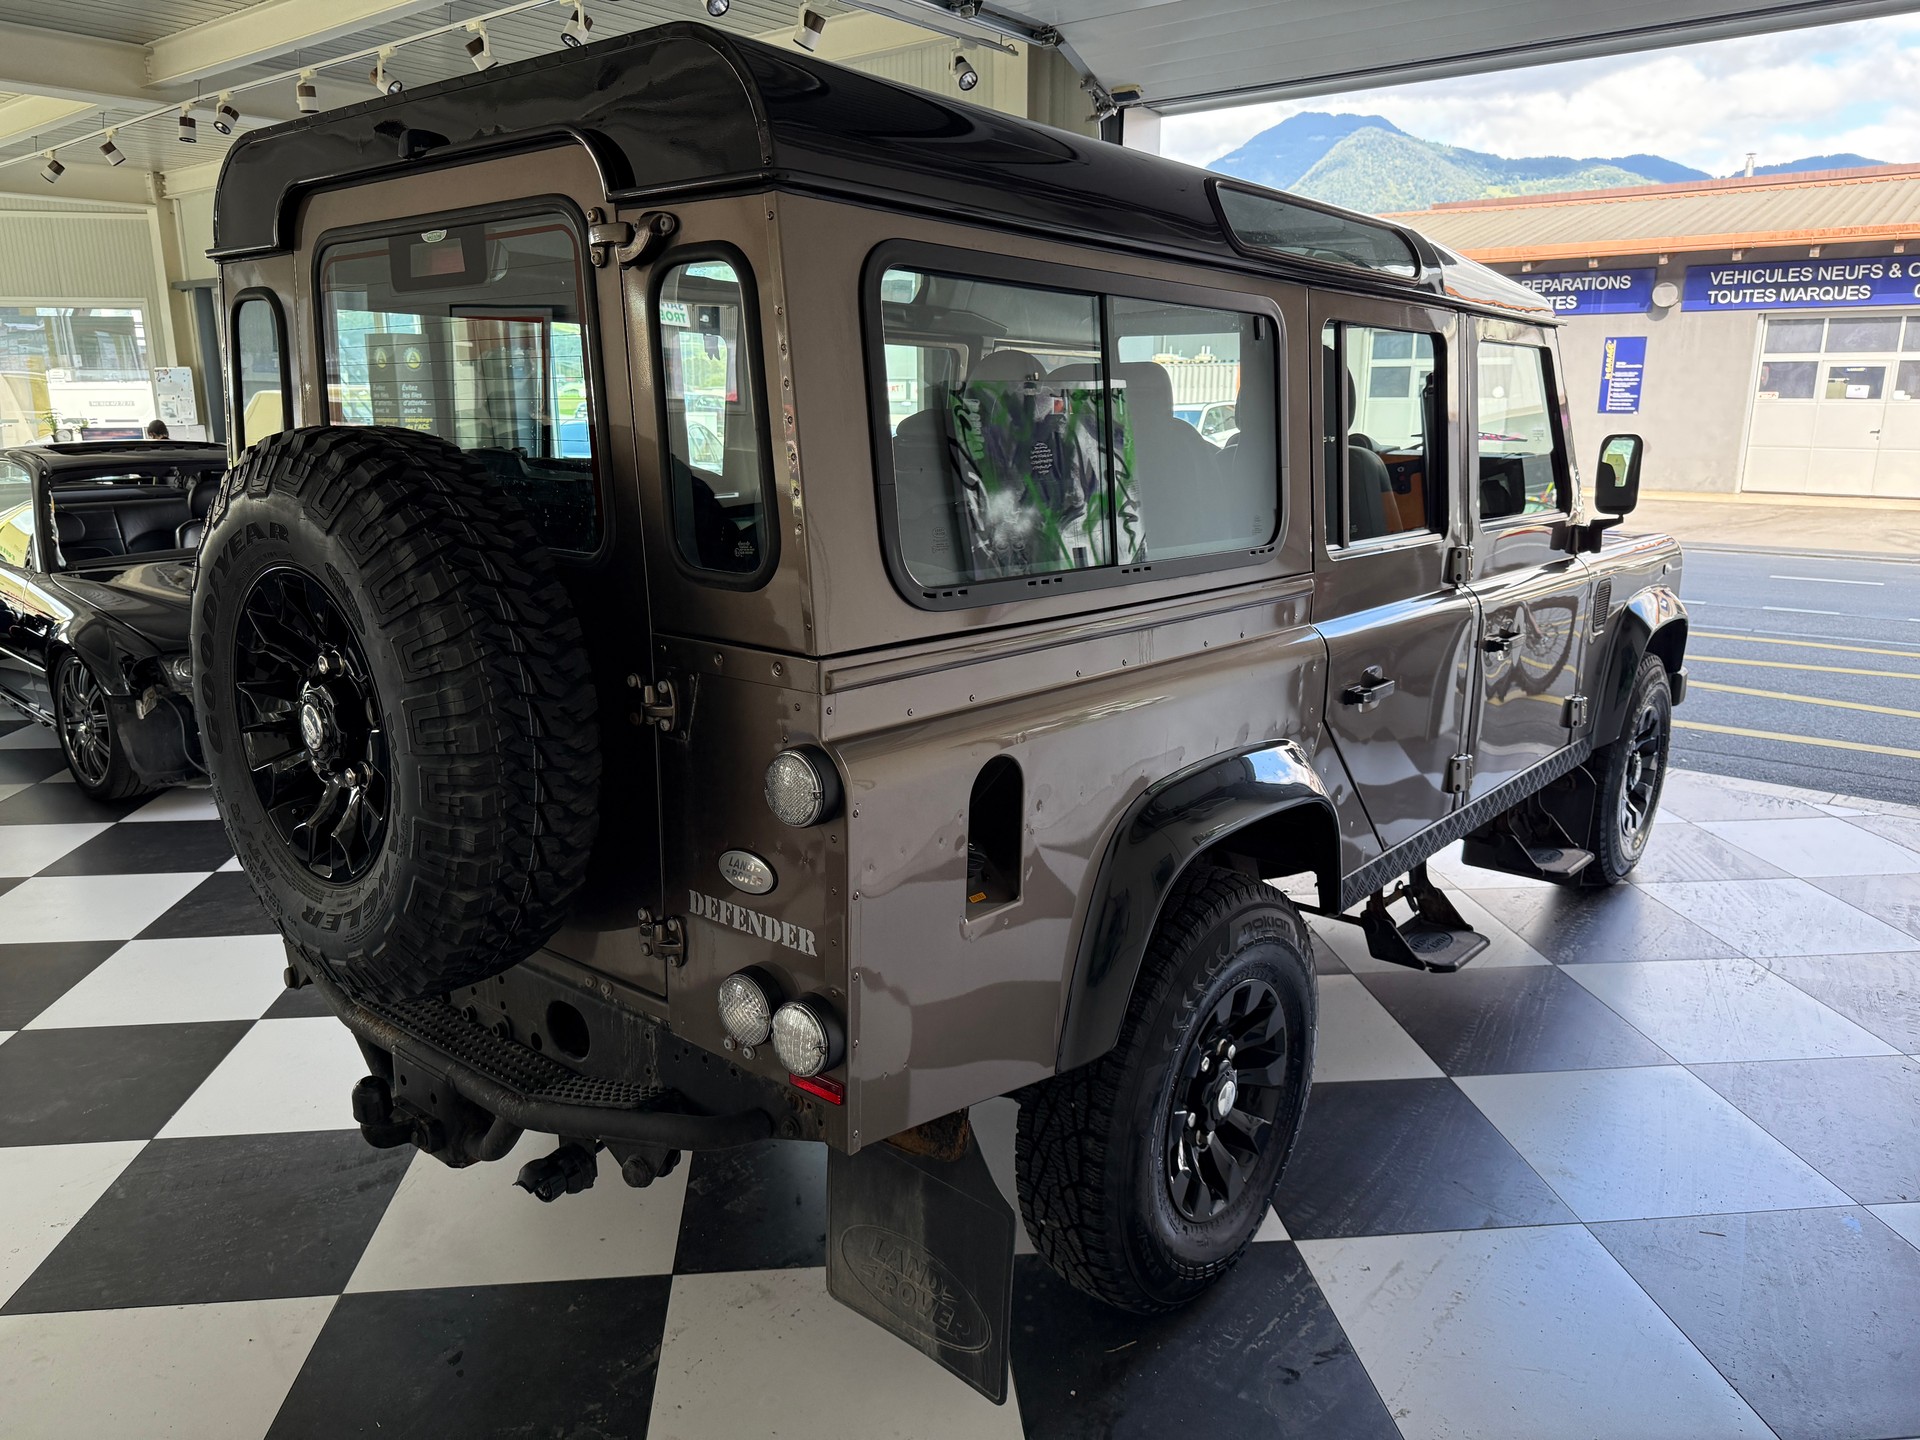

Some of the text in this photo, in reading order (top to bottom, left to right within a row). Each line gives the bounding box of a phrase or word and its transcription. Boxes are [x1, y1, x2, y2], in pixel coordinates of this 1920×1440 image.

[1711, 267, 1813, 285] VEHICULES
[1818, 264, 1883, 281] NEUFS
[1889, 263, 1902, 278] &
[1546, 295, 1577, 310] TES
[1708, 285, 1871, 304] TOUTES MARQUES
[201, 521, 290, 754] GOODYEAR
[728, 856, 756, 872] LAND
[731, 870, 764, 886] ROVER
[688, 889, 818, 957] DEFENDER
[870, 1236, 945, 1297] LAND
[876, 1270, 971, 1341] ROVER
